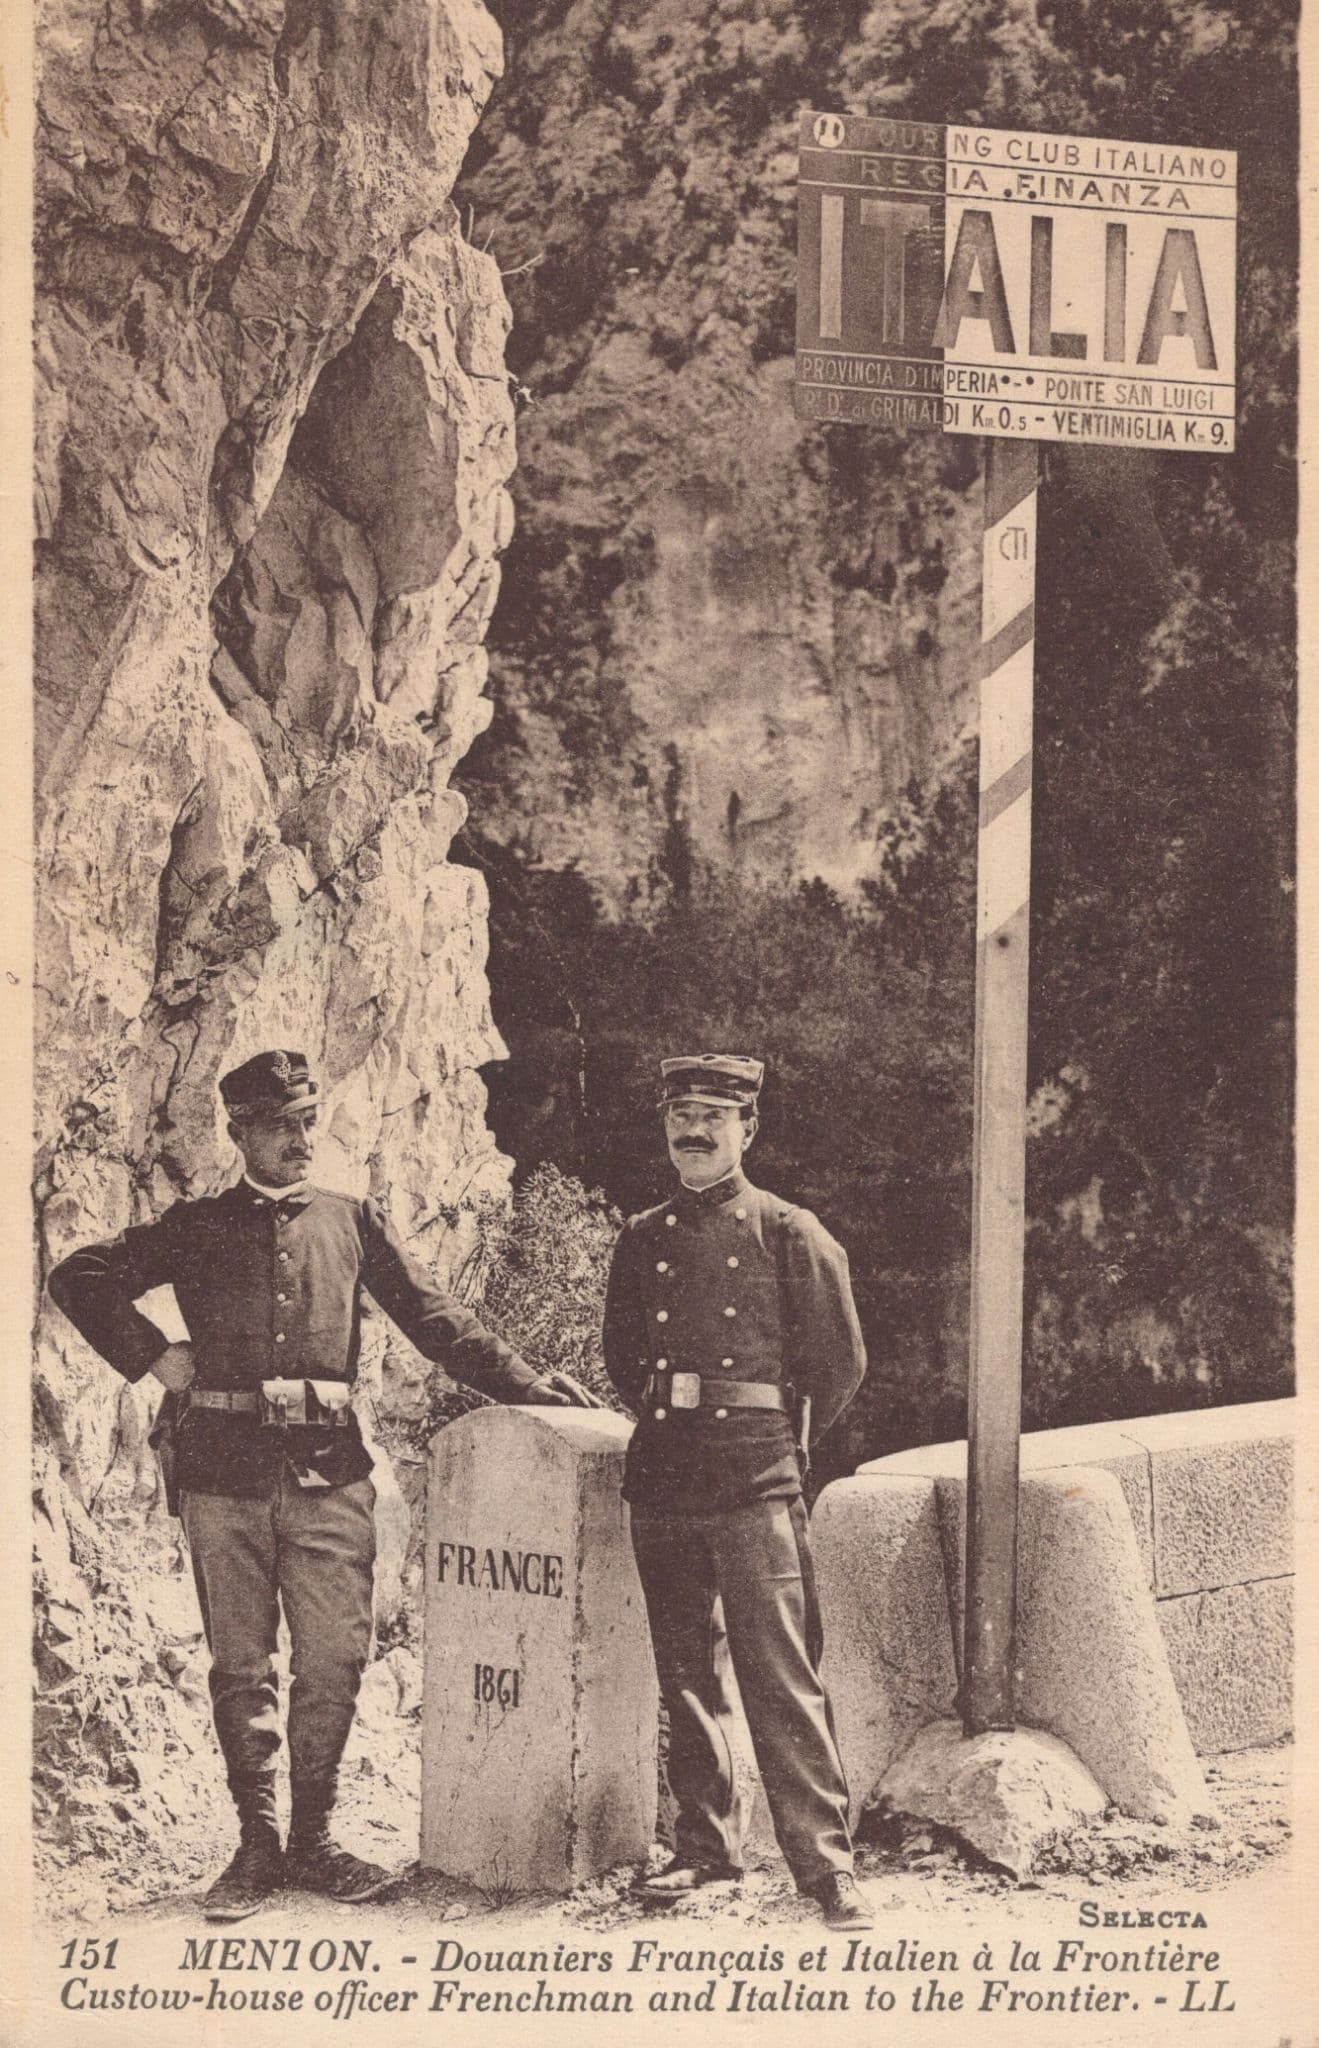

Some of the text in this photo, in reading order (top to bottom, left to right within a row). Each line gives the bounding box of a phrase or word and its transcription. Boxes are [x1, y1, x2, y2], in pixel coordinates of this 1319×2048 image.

[860, 122, 1226, 179] TOURNG CLUB ITALIANO
[861, 158, 1190, 209] REGIA FINANZA
[819, 195, 1218, 370] ITALIA
[802, 357, 894, 385] PROVINCIA
[1046, 378, 1105, 403] PONTE
[1115, 383, 1153, 406] SAN
[1163, 387, 1214, 410] LUIGI
[871, 397, 959, 425] GRIMALDI
[1053, 410, 1177, 442] VENTIMIGLIA
[437, 1541, 564, 1599] FRANCE
[473, 1663, 520, 1709] 1861
